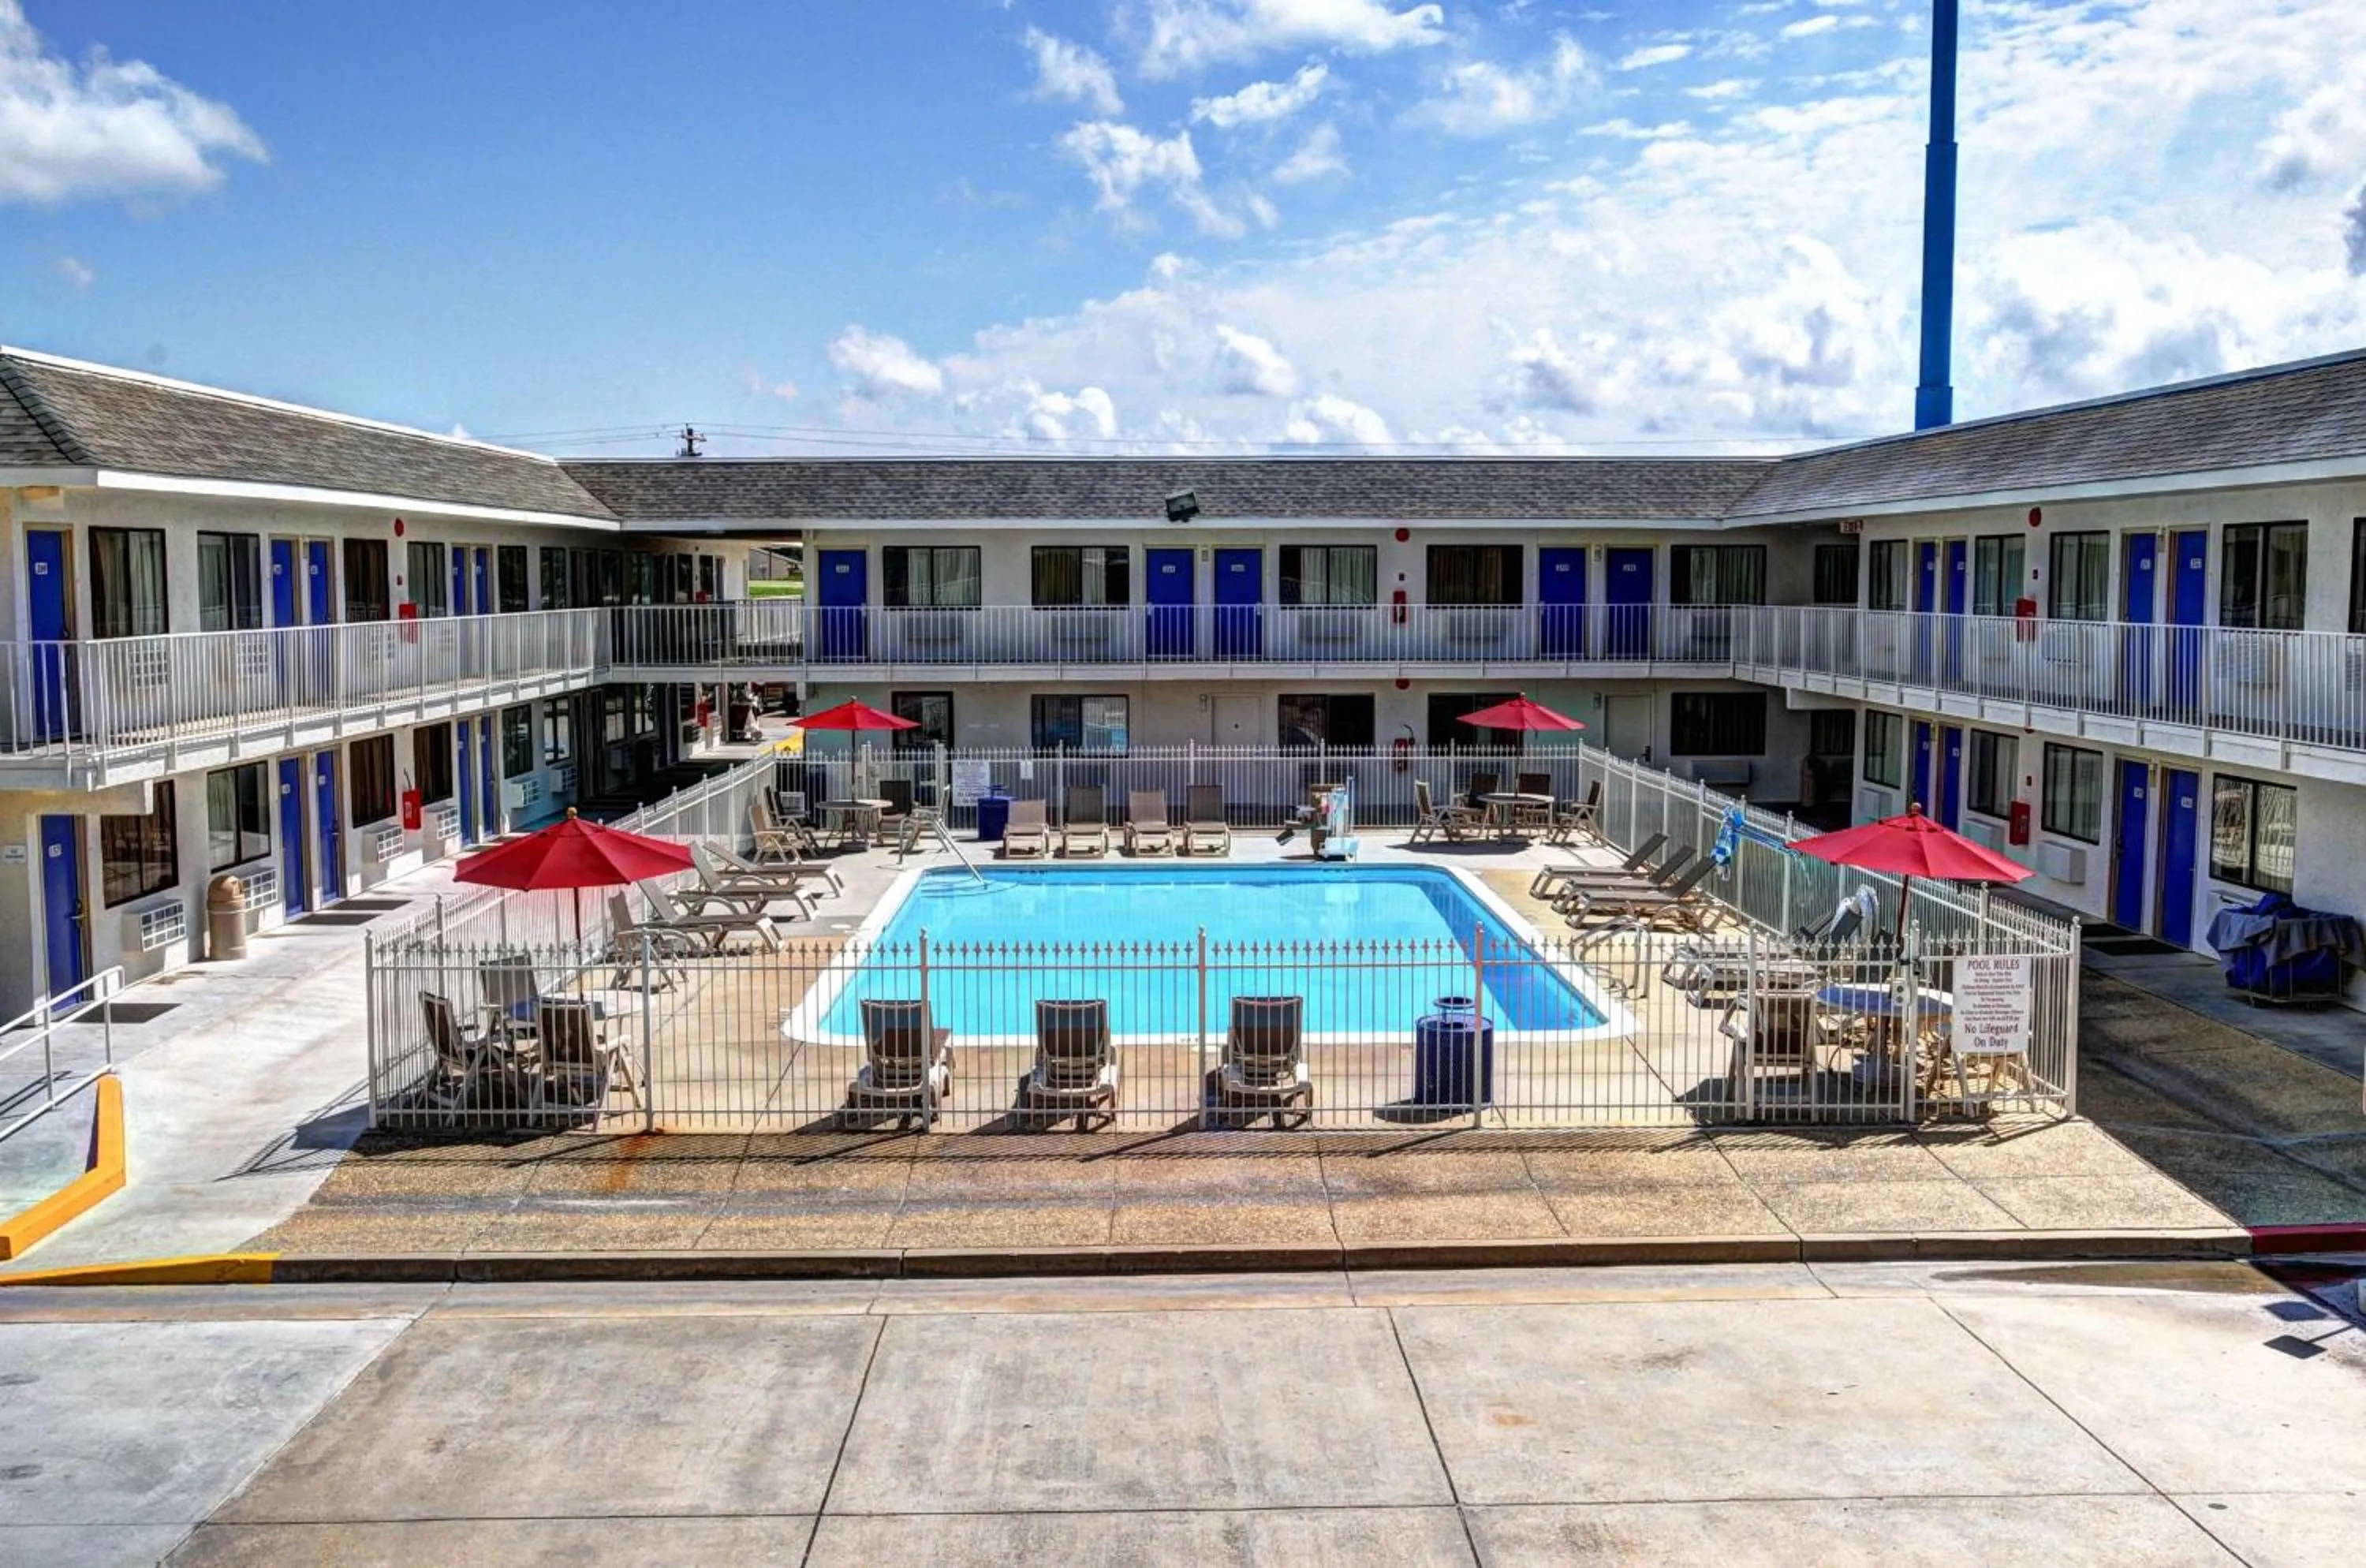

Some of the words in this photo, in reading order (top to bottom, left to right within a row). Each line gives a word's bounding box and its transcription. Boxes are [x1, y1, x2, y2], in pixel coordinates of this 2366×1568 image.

[1967, 959, 1991, 970] POOL
[1993, 958, 2020, 970] RULES
[1965, 1024, 1977, 1034] No
[1979, 1023, 2018, 1036] Lifeguard
[1973, 1036, 1987, 1047] On
[1989, 1036, 2010, 1049] Duty
